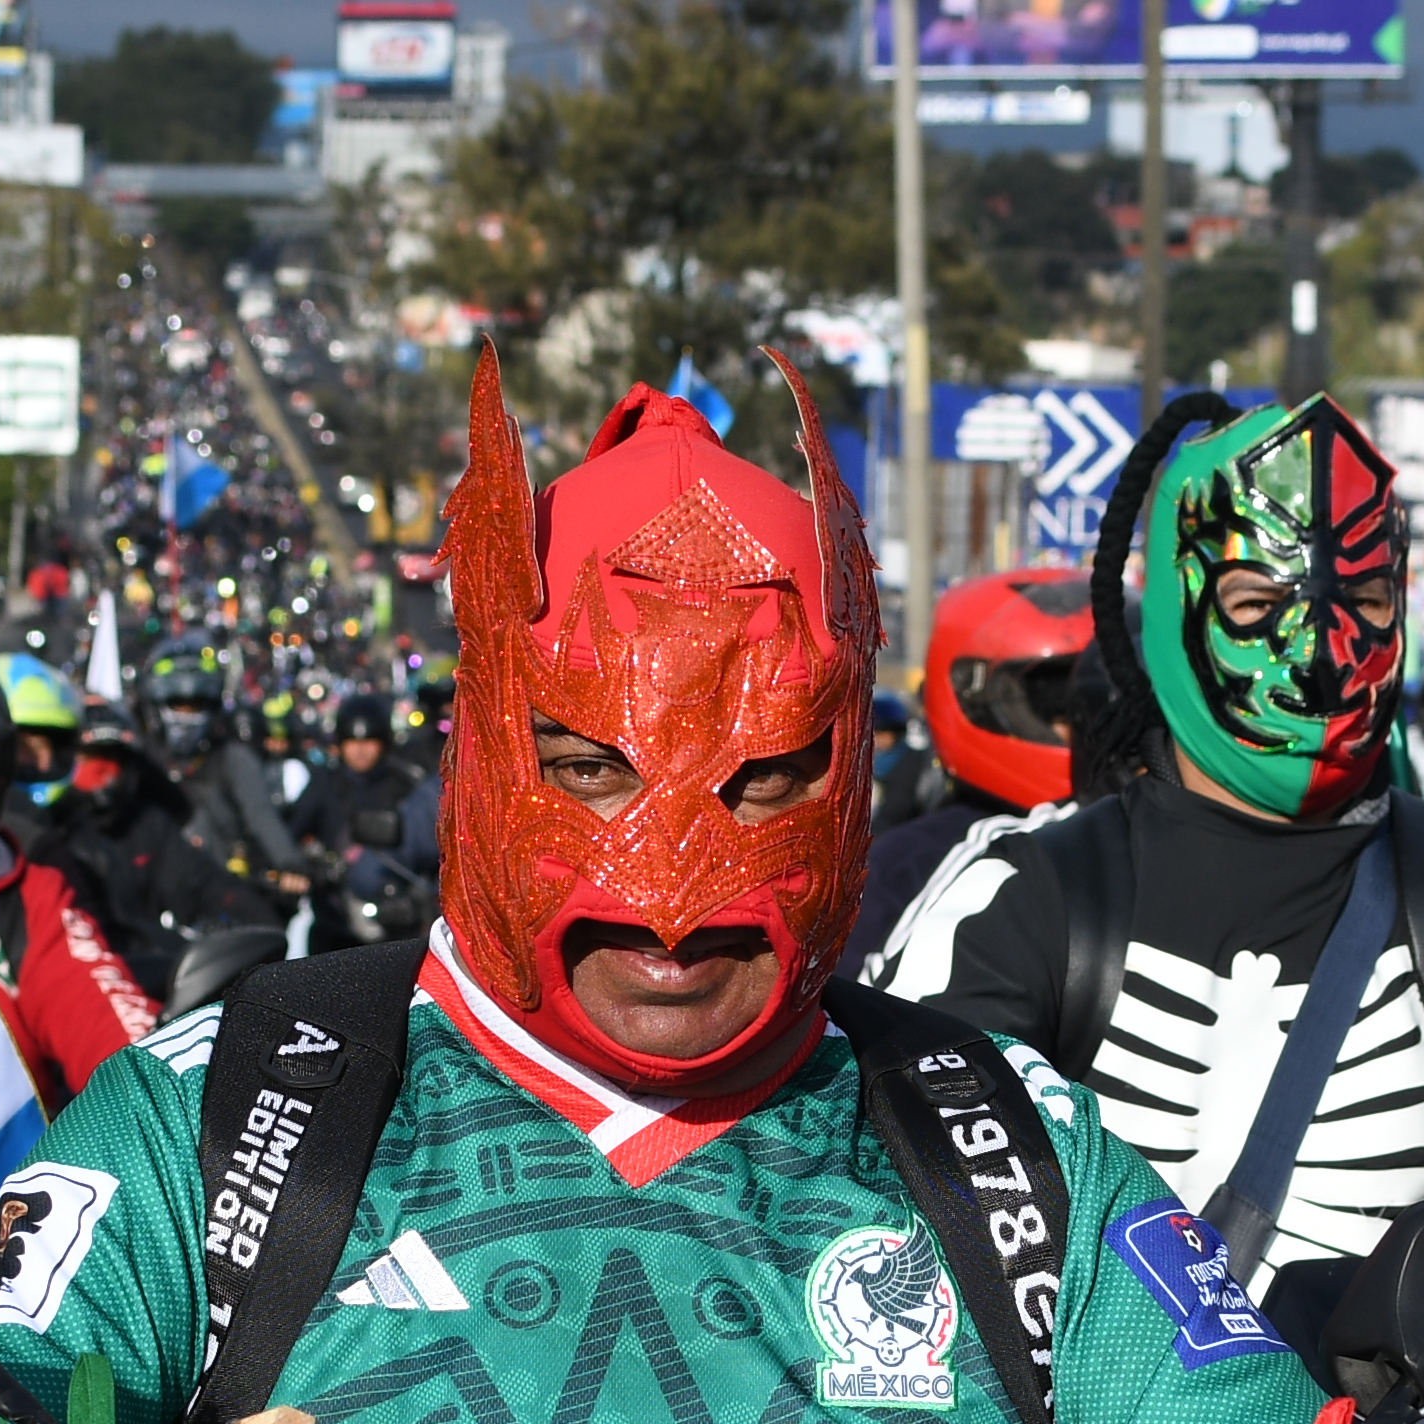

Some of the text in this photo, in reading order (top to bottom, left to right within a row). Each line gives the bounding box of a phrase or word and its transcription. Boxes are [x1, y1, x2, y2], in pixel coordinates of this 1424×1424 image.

[205, 1088, 285, 1256] EDITION
[229, 1096, 313, 1270] LIMITED
[1225, 1318, 1259, 1330] FIFA
[828, 1365, 953, 1399] MÉXICO
